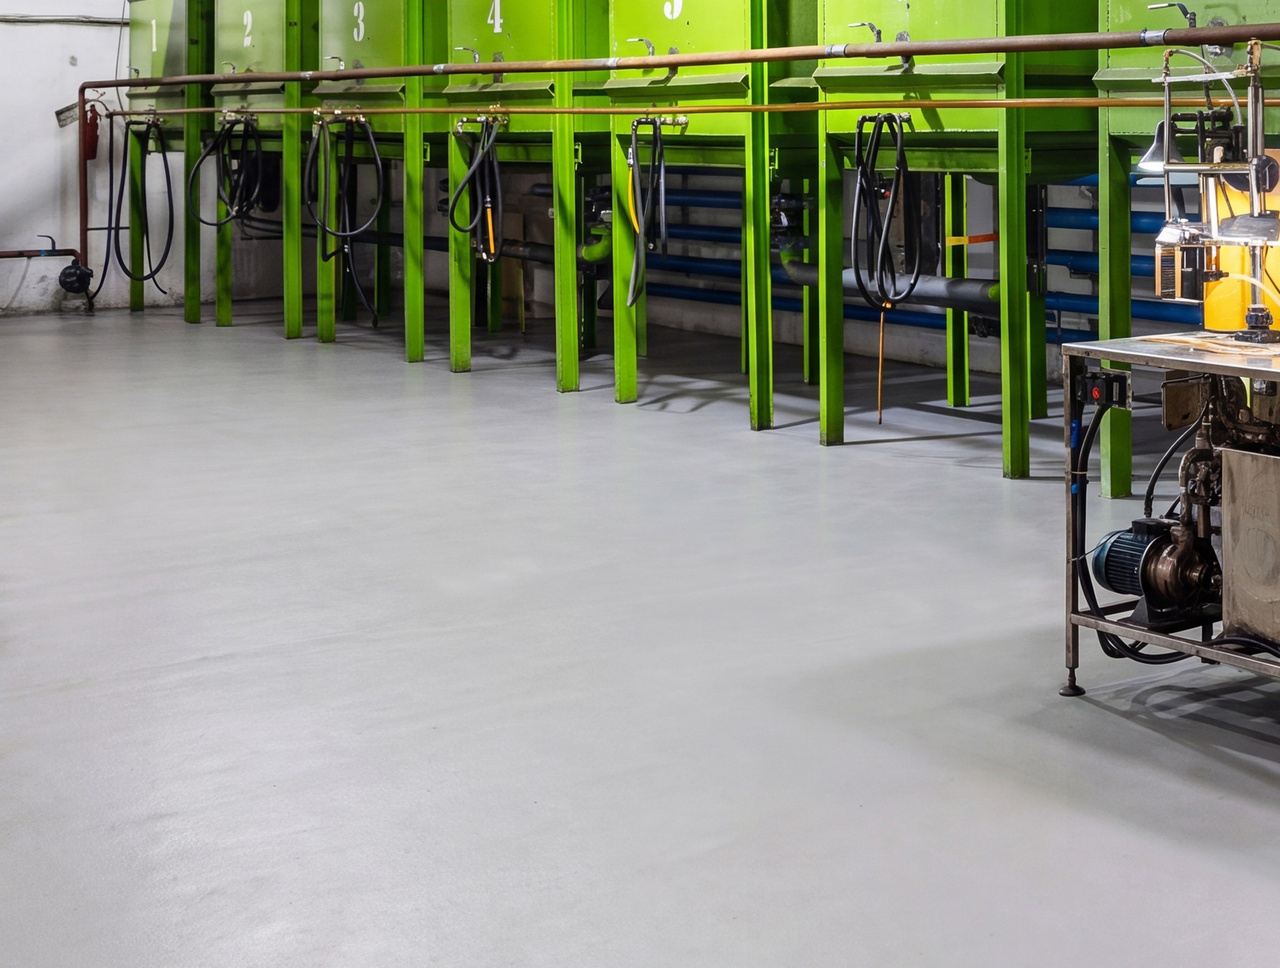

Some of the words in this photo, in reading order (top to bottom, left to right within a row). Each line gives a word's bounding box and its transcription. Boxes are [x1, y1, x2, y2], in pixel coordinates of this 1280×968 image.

[150, 18, 157, 52] 1
[243, 9, 253, 48] 2
[353, 1, 365, 42] 3
